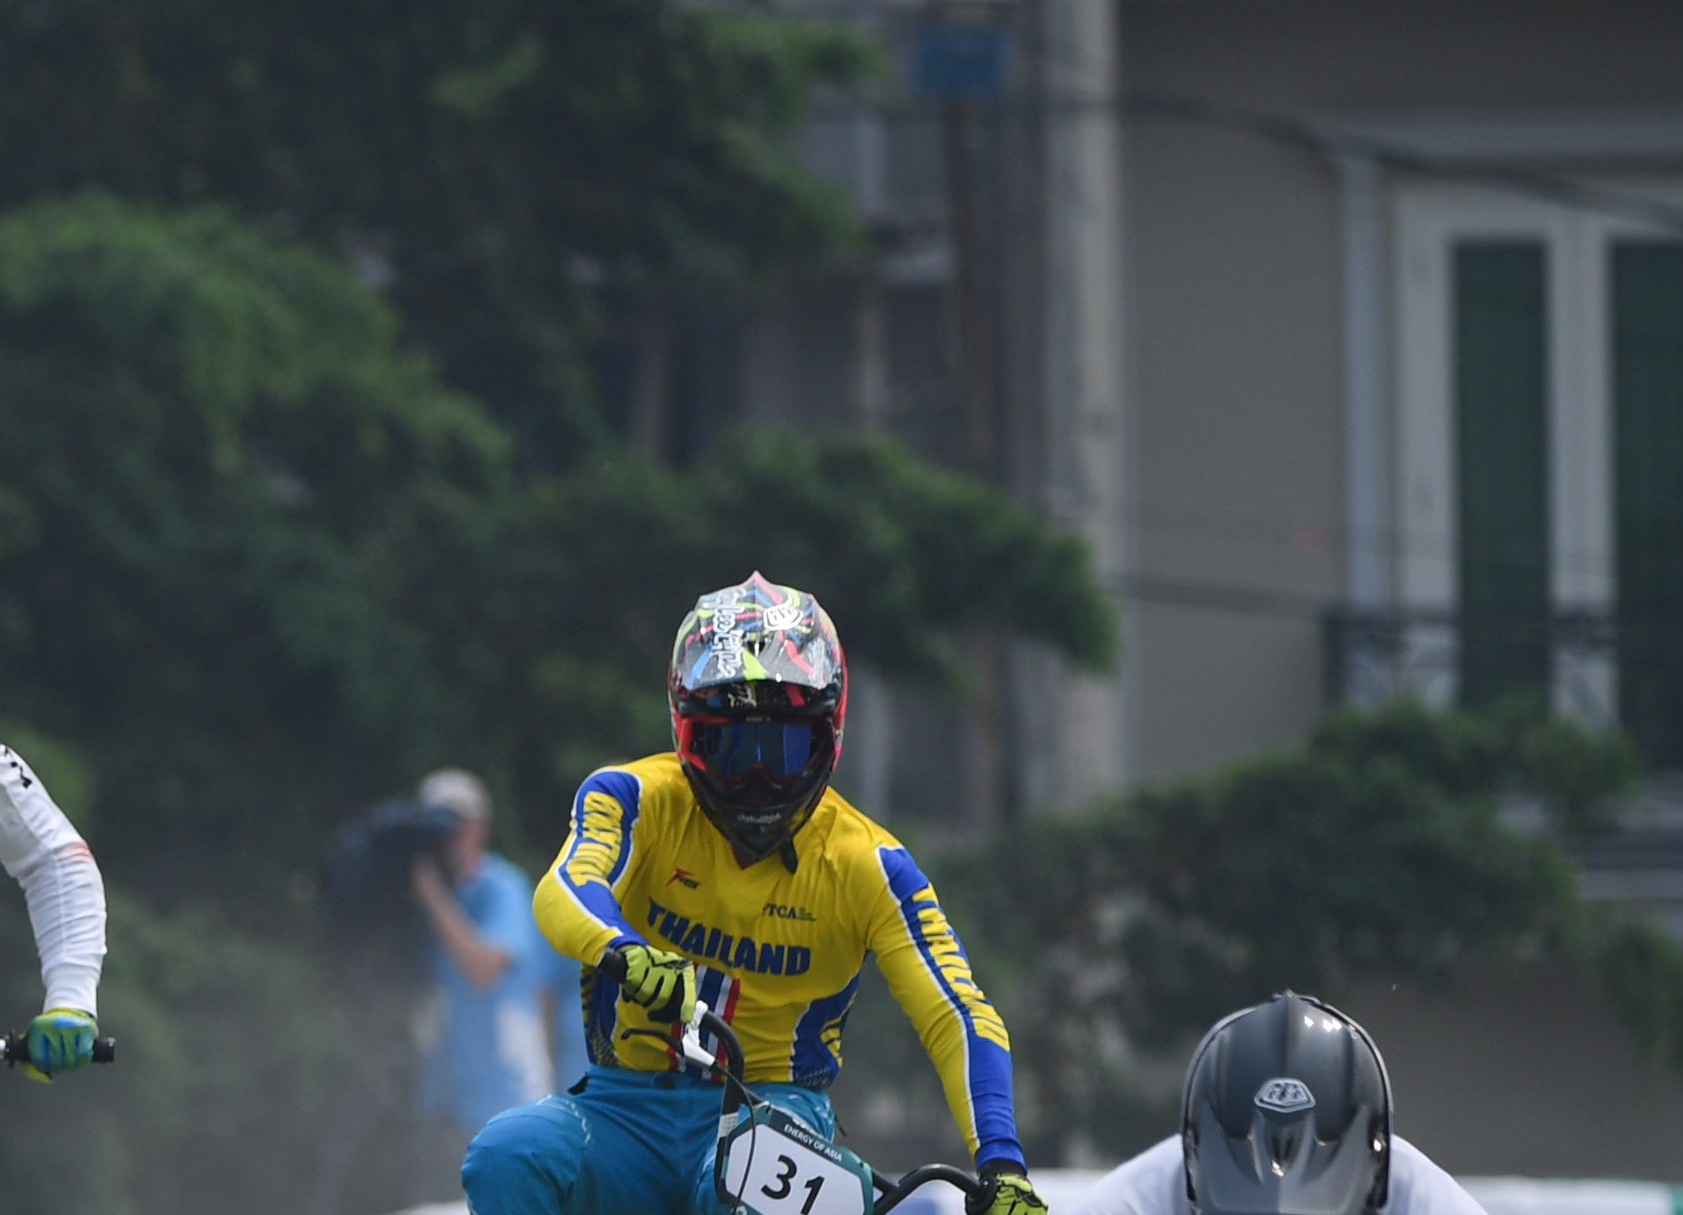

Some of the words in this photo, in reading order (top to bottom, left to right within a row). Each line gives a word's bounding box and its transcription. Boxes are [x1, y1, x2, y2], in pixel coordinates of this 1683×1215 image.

[646, 896, 812, 977] THAILAND
[784, 1123, 814, 1146] ENERGY
[813, 1140, 825, 1152] OF
